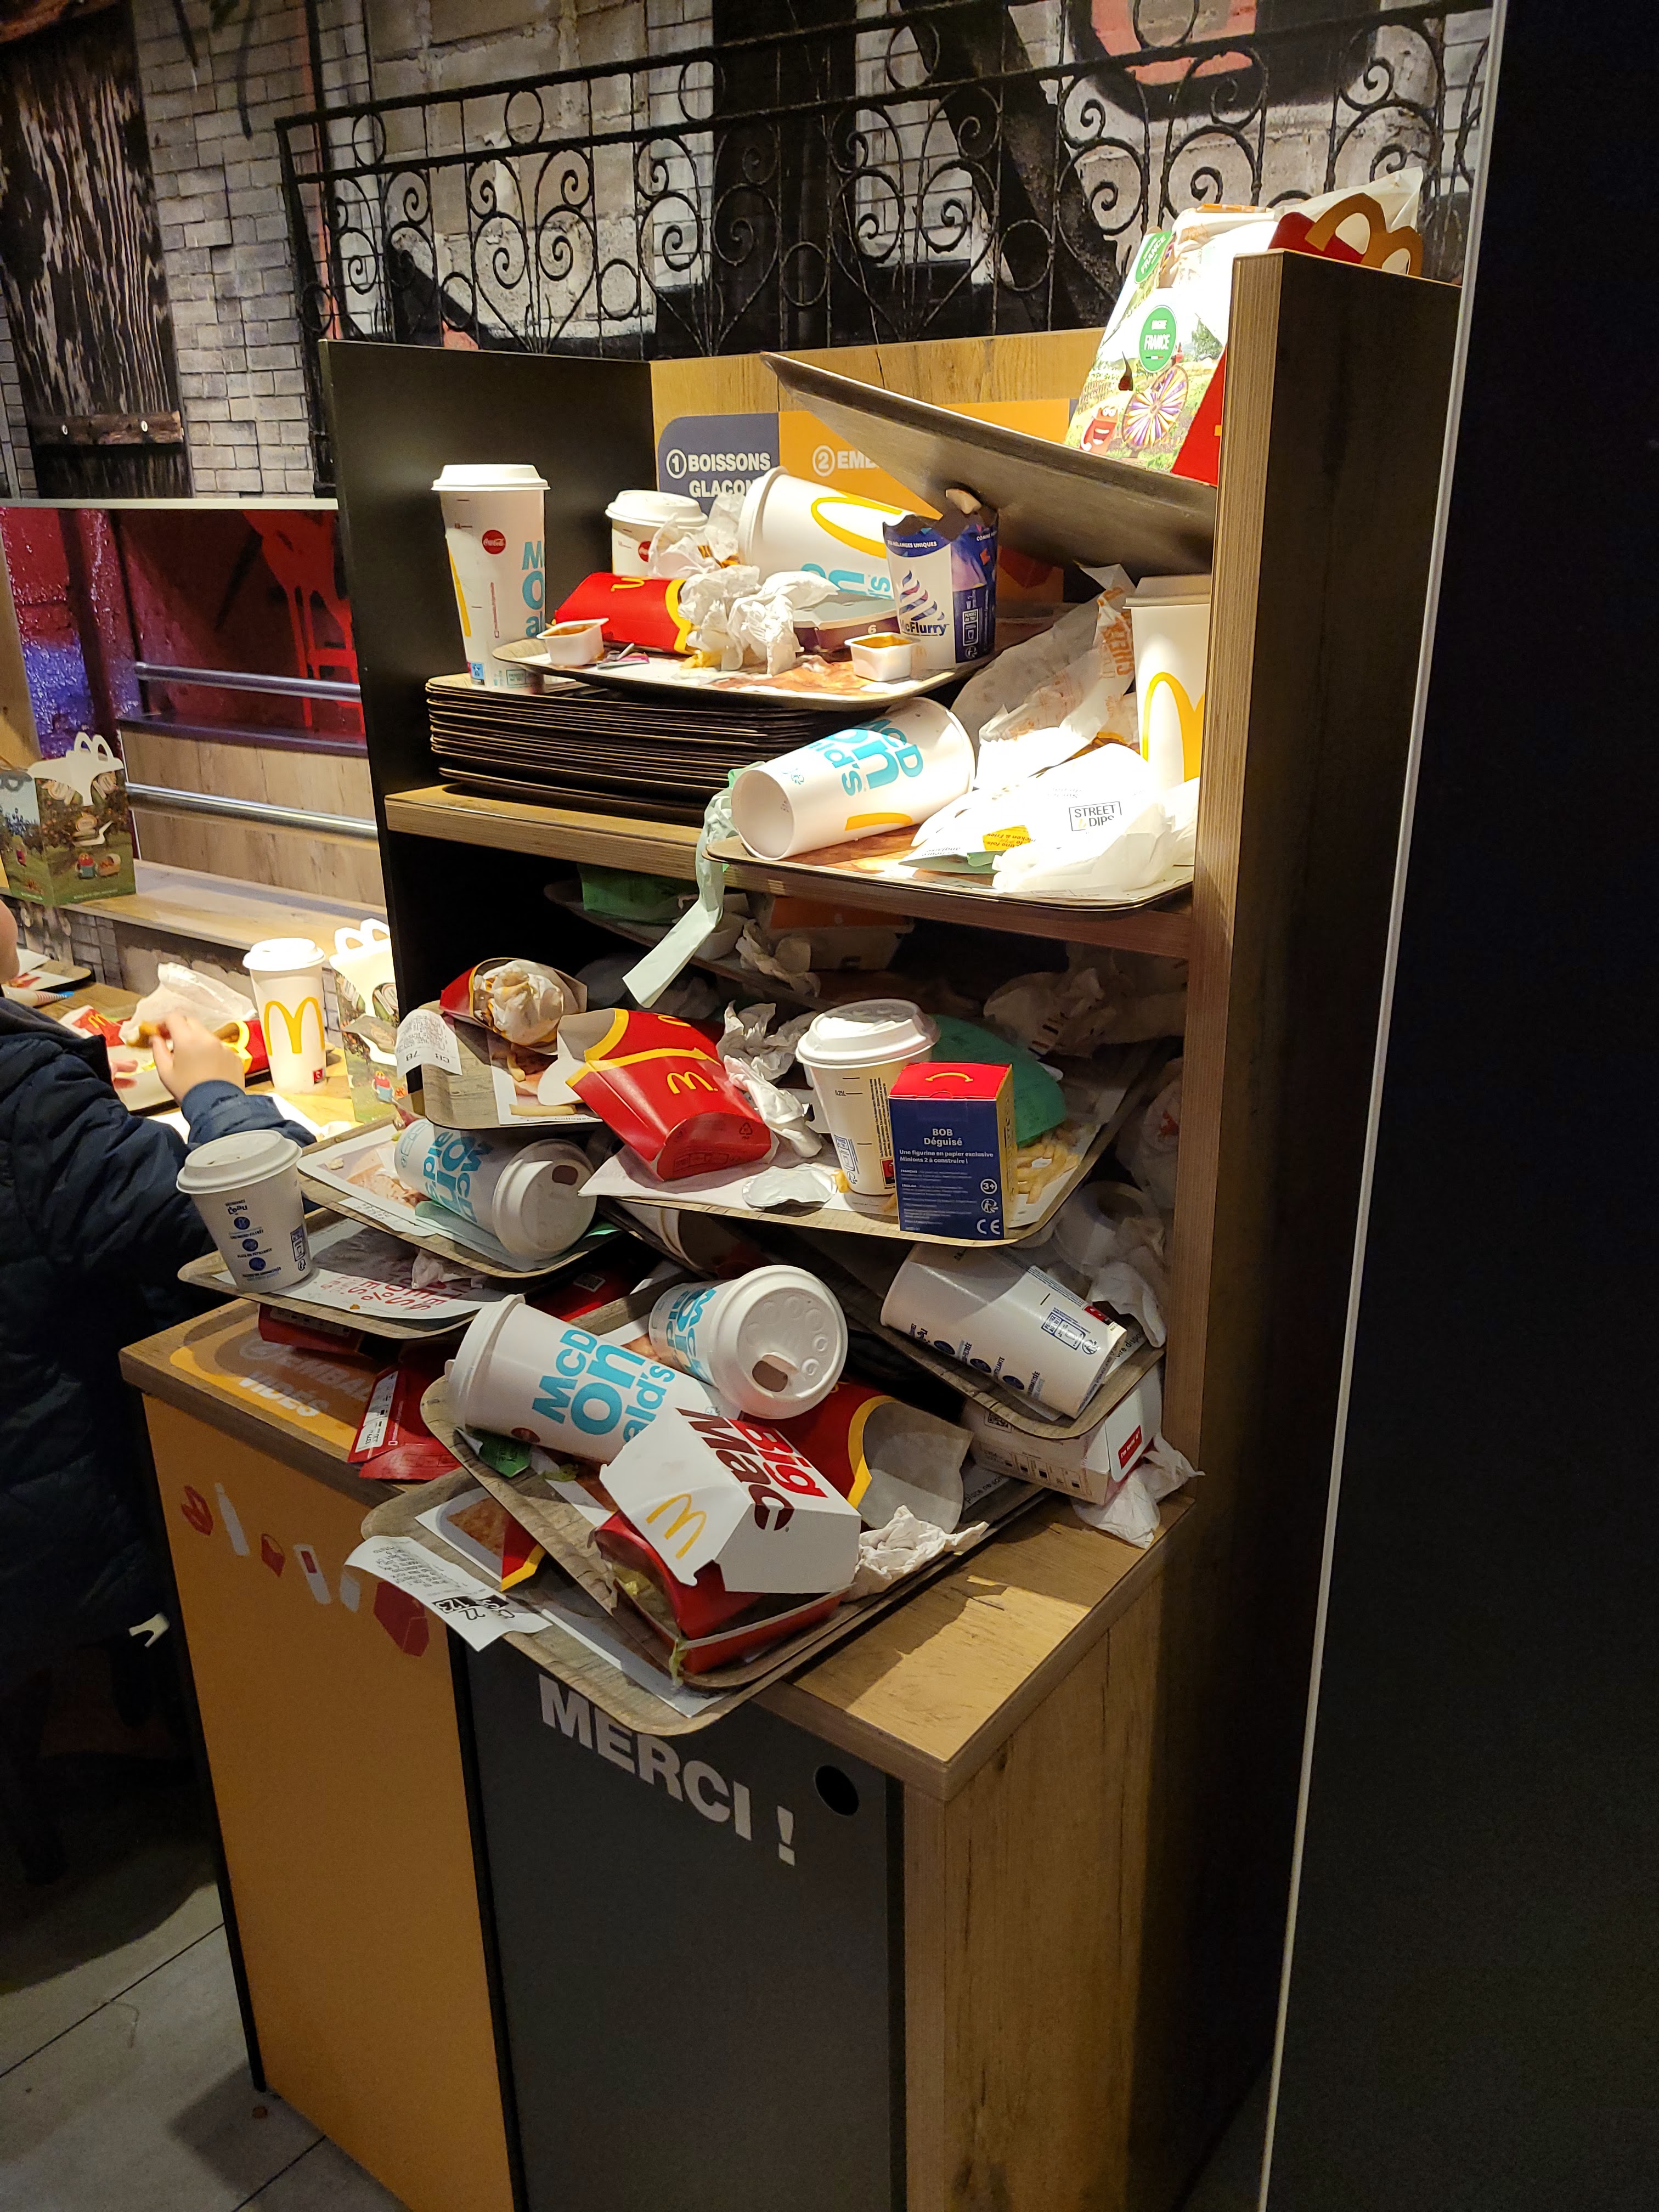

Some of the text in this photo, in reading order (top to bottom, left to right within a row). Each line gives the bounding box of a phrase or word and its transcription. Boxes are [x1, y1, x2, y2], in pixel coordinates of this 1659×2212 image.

[1141, 235, 1167, 274] FRANCE
[1144, 334, 1171, 350] FRANCE
[687, 452, 771, 472] BOISSONS
[867, 624, 877, 635] 6
[1074, 804, 1116, 818] STREET
[923, 1137, 963, 1147] Déguisé
[932, 1128, 953, 1136] BOB
[983, 1182, 996, 1190] 3+
[239, 1371, 329, 1417] VIDES
[532, 1329, 597, 1424] McD
[571, 1344, 646, 1435] on
[623, 1365, 675, 1443] ald's
[675, 1407, 795, 1531] Mac
[728, 1418, 829, 1498] Big
[538, 1673, 796, 1866] MERCI !
